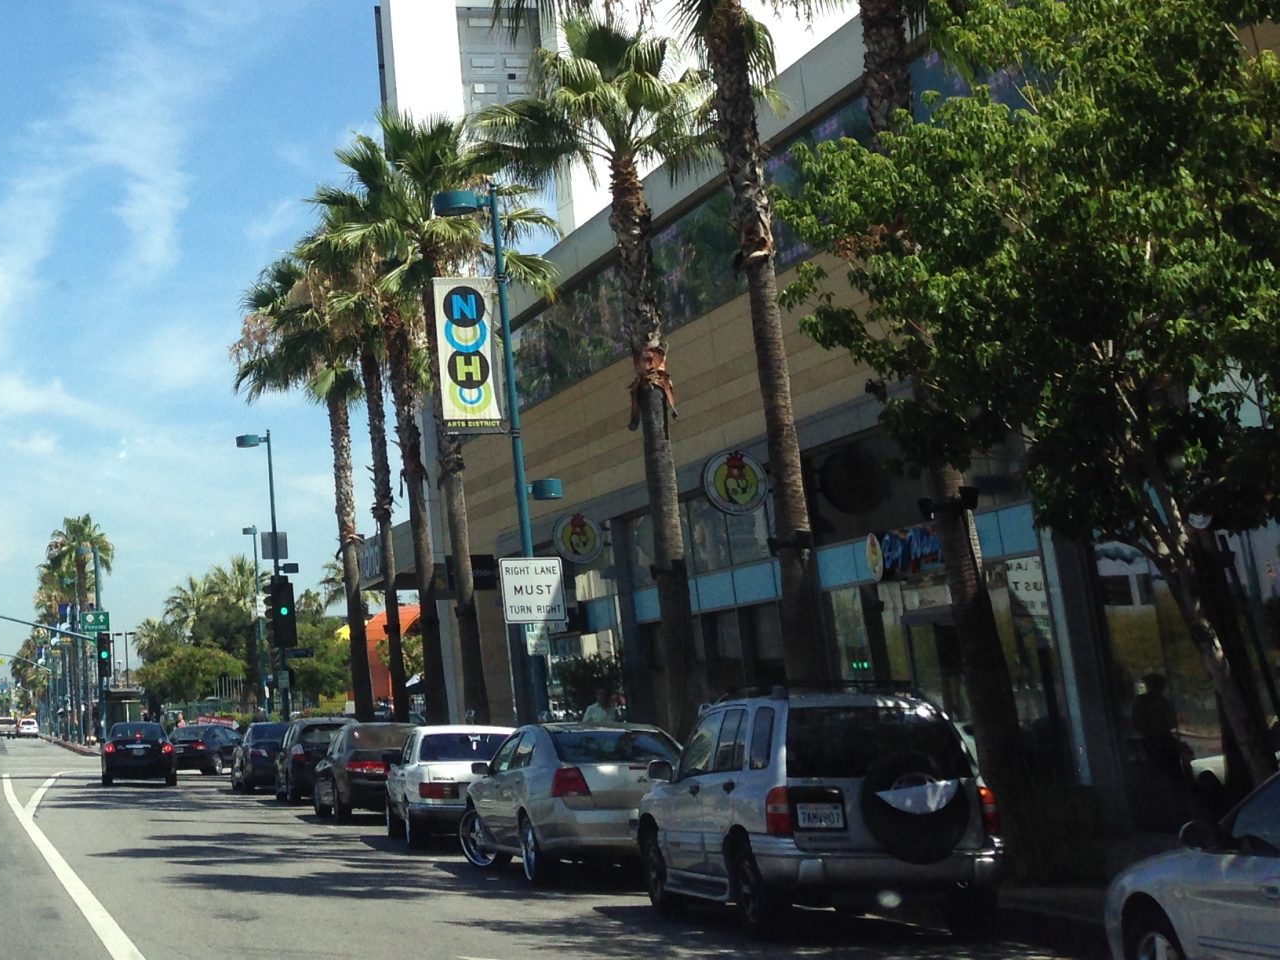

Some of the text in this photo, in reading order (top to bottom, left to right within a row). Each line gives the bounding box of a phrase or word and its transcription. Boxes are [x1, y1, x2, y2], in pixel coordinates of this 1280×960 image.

[467, 420, 500, 428] DISTRICT
[504, 566, 530, 576] RIGHT
[534, 565, 558, 575] LANE
[513, 584, 553, 596] MUST
[508, 604, 562, 615] TURN RIGHT
